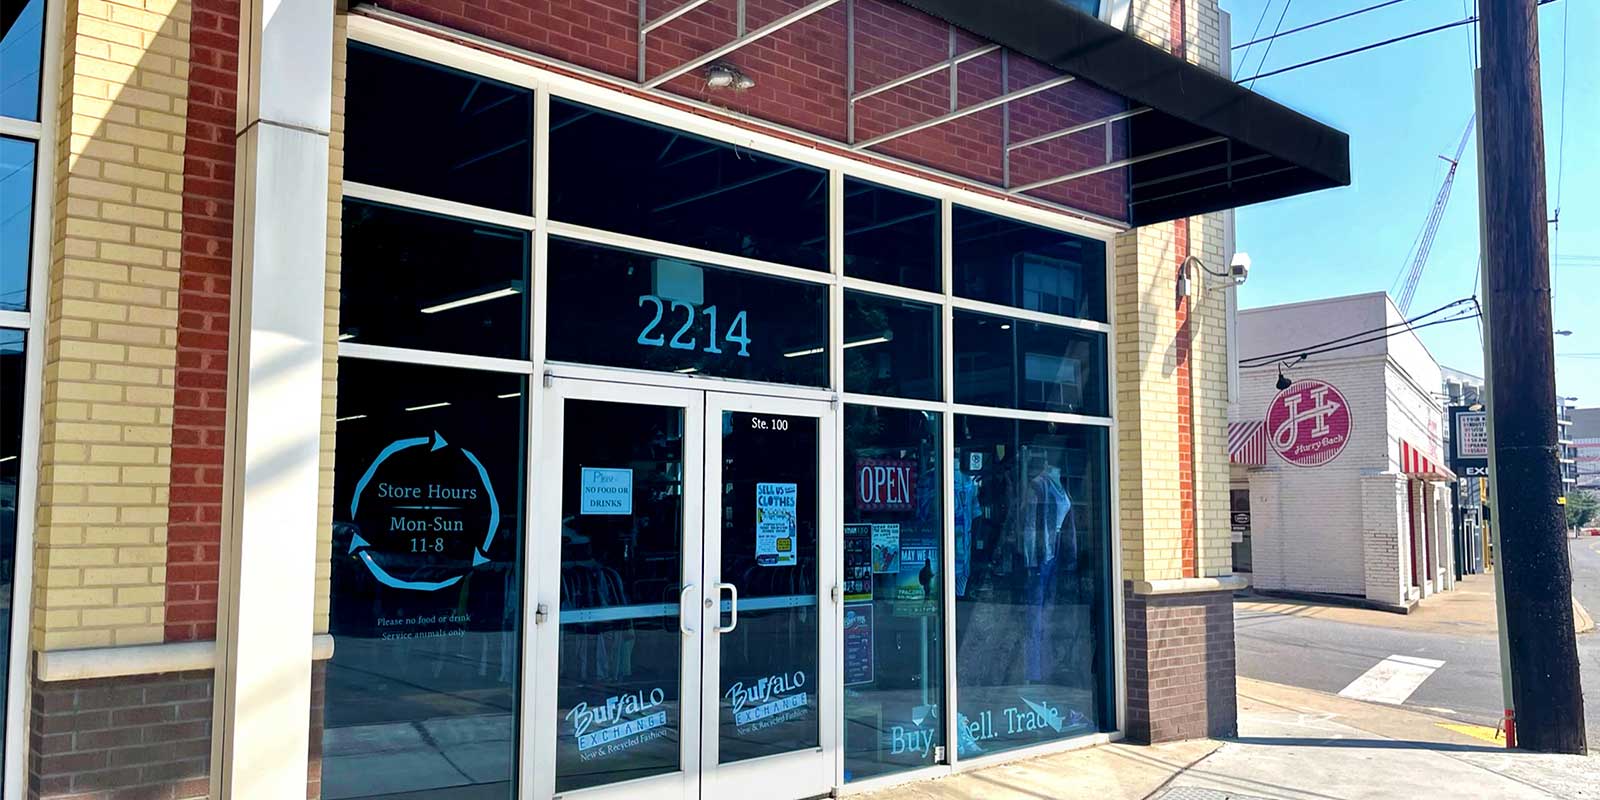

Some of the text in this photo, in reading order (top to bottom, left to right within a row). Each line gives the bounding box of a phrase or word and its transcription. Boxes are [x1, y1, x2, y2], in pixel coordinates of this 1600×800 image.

[637, 295, 752, 357] 2214
[751, 417, 789, 431] Ste. 100
[1295, 434, 1344, 455] Hurry Back
[377, 482, 477, 500] Store Hours
[585, 486, 596, 494] NO
[758, 484, 775, 496] SELL
[776, 486, 785, 496] US
[860, 466, 911, 504] OPEN
[590, 499, 622, 508] DRINKS
[758, 496, 796, 507] CLOTHES
[390, 516, 464, 532] Mon-Sun
[410, 538, 445, 553] 11-8
[901, 549, 915, 561] MAY
[916, 549, 926, 561] WE
[377, 613, 471, 627] Please no food or drink
[382, 627, 466, 641] Service animals only
[736, 692, 807, 726] EXCHANGE
[578, 711, 667, 750] EXCHANGE
[752, 723, 759, 731] &
[580, 729, 668, 762] New & Recycled Fashion
